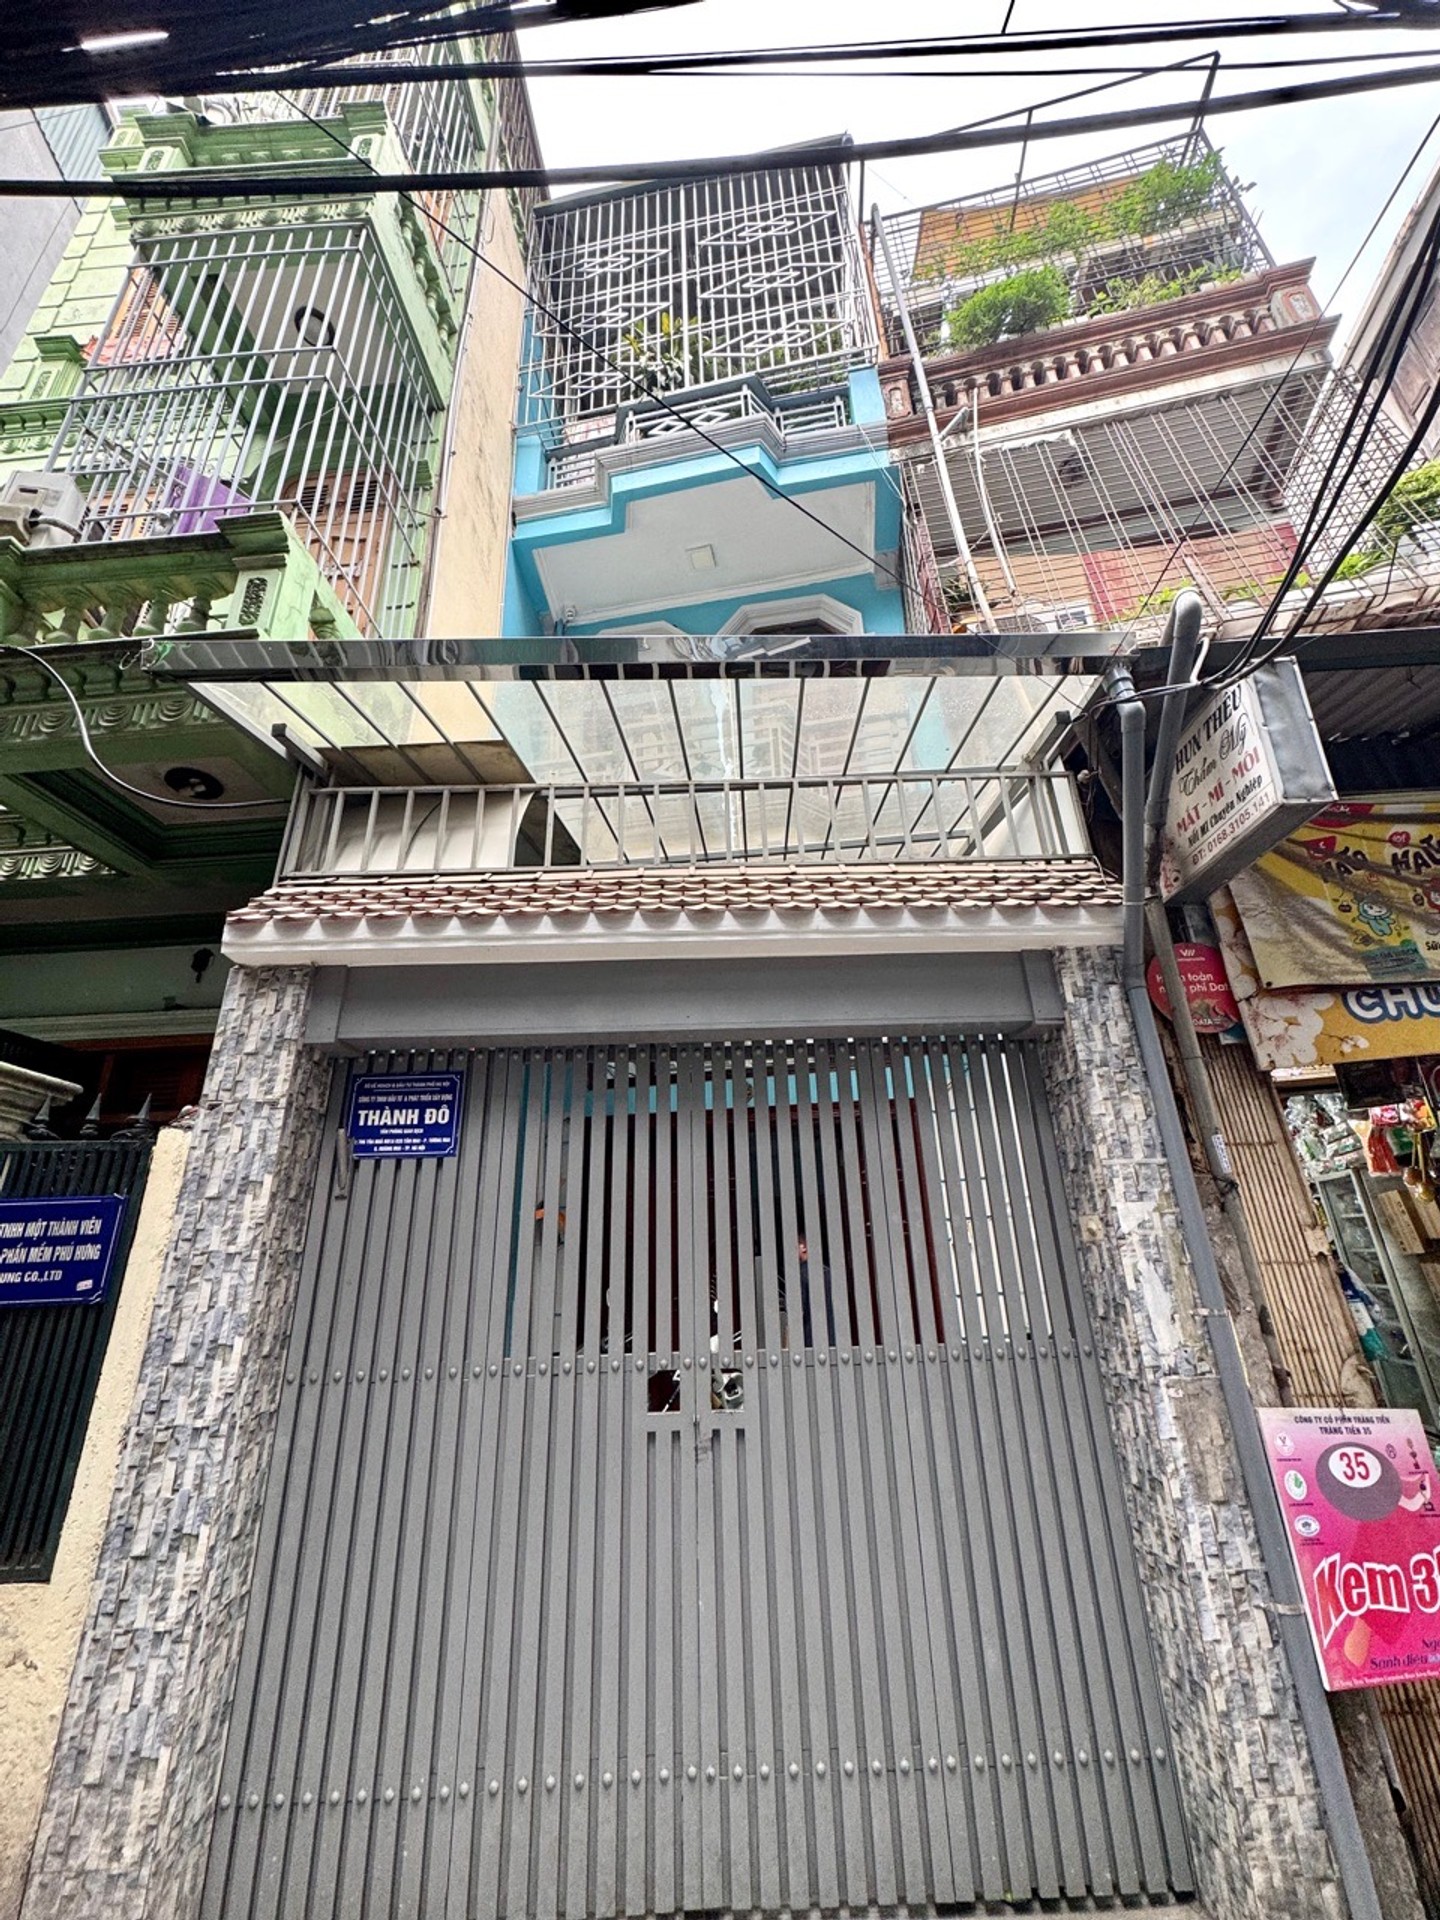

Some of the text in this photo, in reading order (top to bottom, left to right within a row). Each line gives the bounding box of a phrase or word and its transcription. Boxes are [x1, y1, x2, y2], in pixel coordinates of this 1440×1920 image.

[358, 1104, 450, 1126] THÀNH ĐÔ
[24, 1218, 47, 1240] MỘT
[47, 1217, 79, 1237] THÀNH
[79, 1216, 102, 1236] VIÊN
[53, 1241, 75, 1262] PHÚ
[74, 1242, 102, 1261] HƯNG
[1339, 1451, 1371, 1481] 35
[1313, 1553, 1410, 1648] Kem
